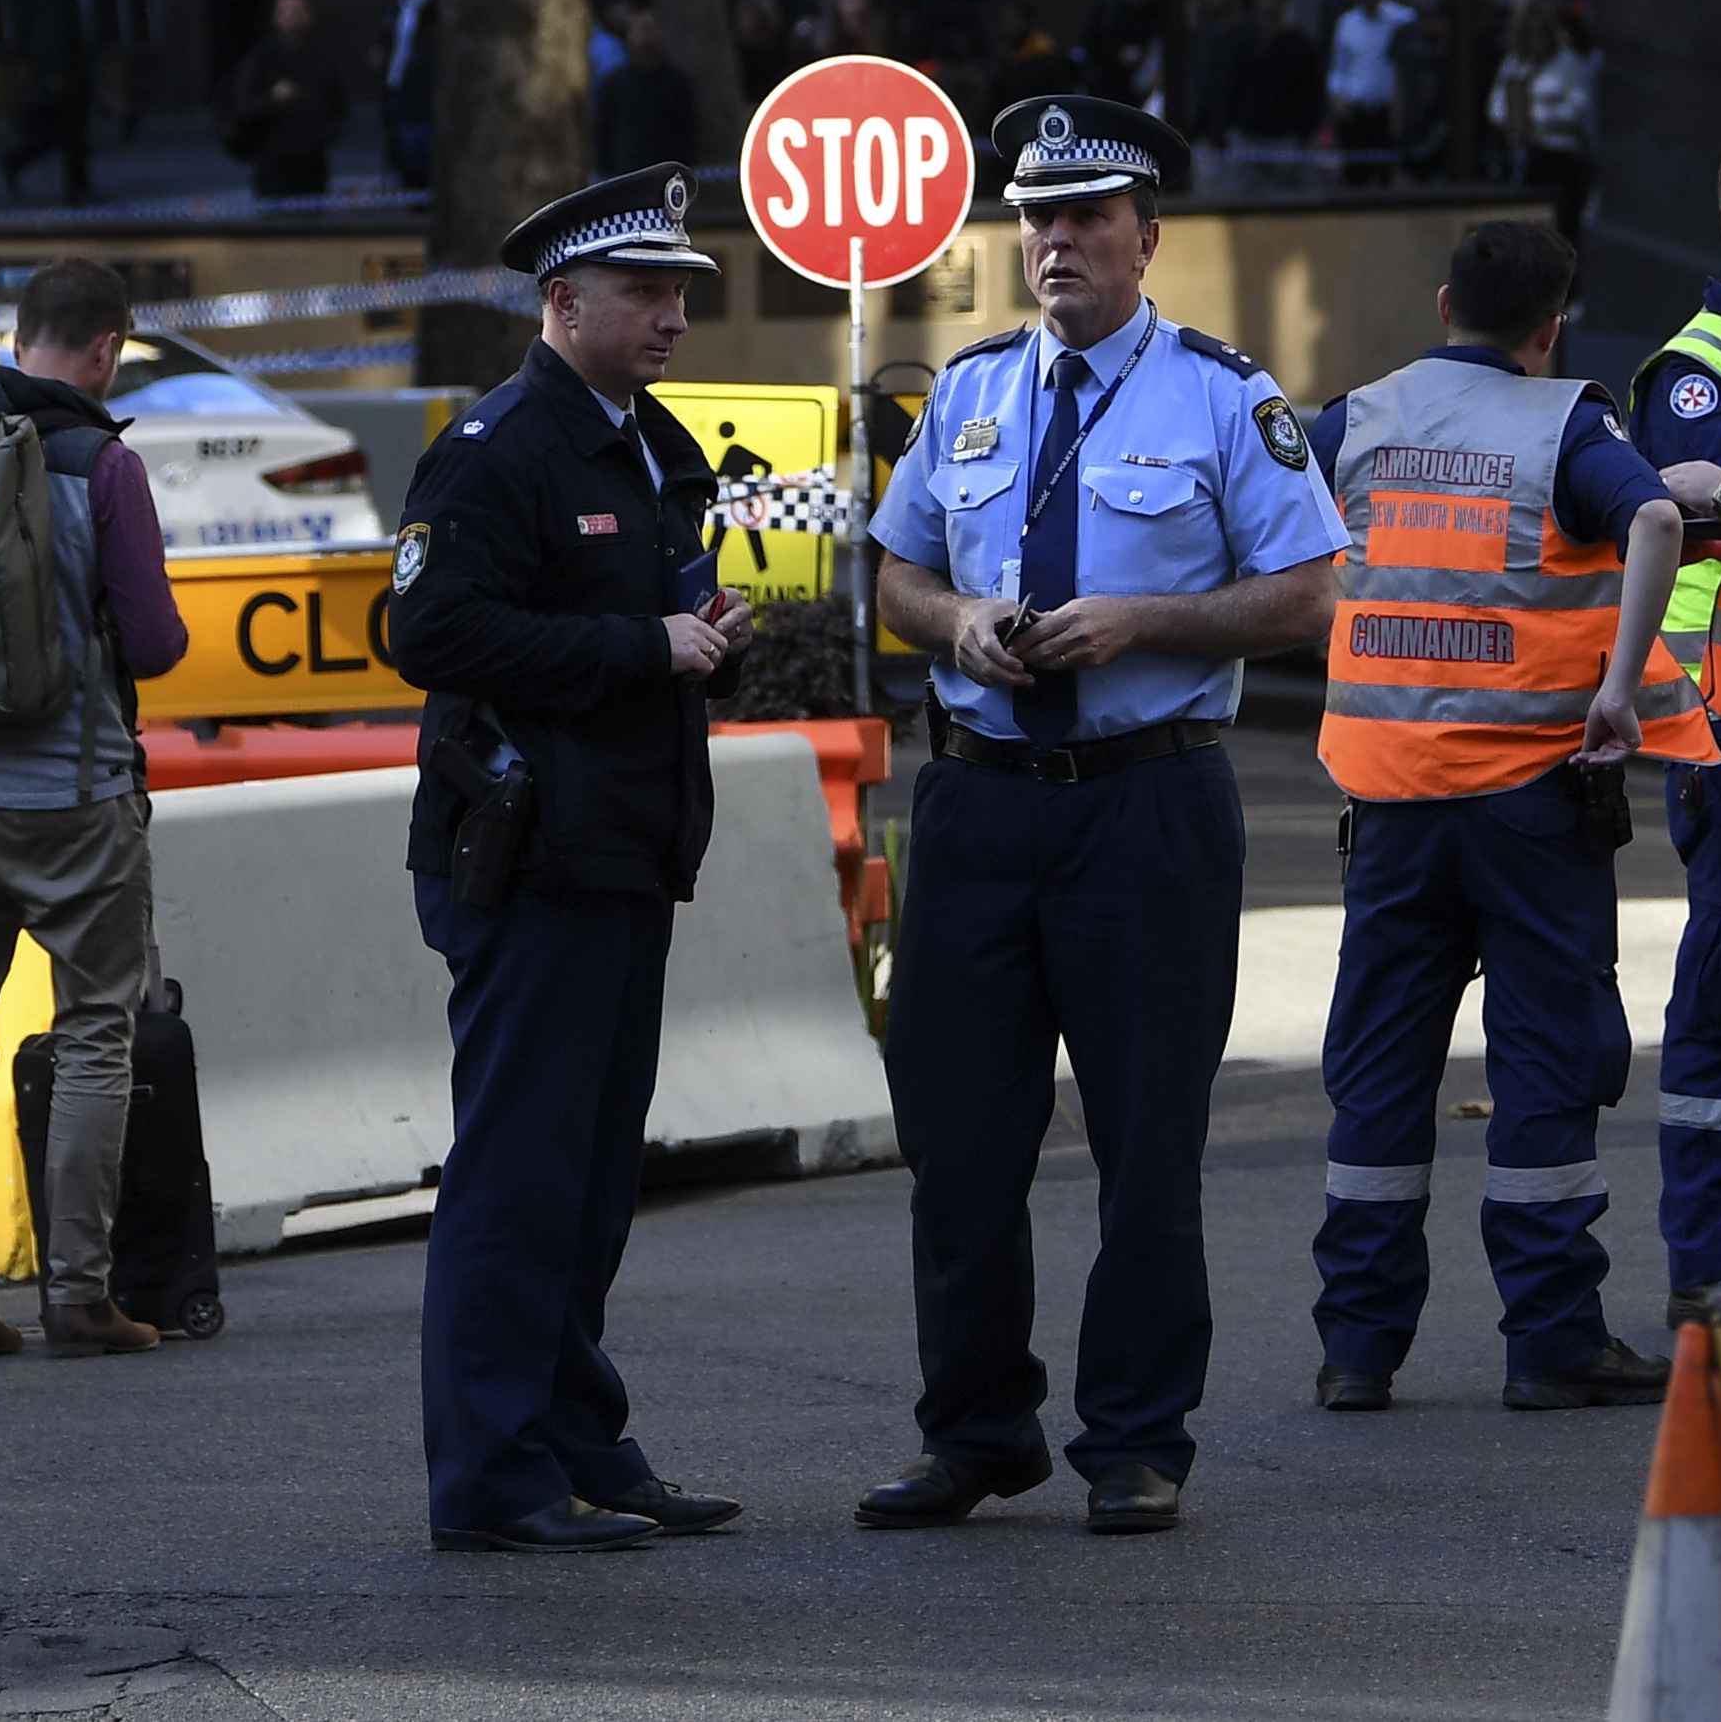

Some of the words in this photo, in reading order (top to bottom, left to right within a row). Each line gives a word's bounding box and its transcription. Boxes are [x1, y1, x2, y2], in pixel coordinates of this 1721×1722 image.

[767, 116, 950, 229] STOP
[1058, 448, 1075, 473] POLICE
[1371, 446, 1516, 488] AMBULANCE
[1369, 500, 1398, 528] NEW
[1401, 501, 1450, 531] SOUTH
[1454, 505, 1507, 536] WALES
[1350, 613, 1516, 665] COMMANDER
